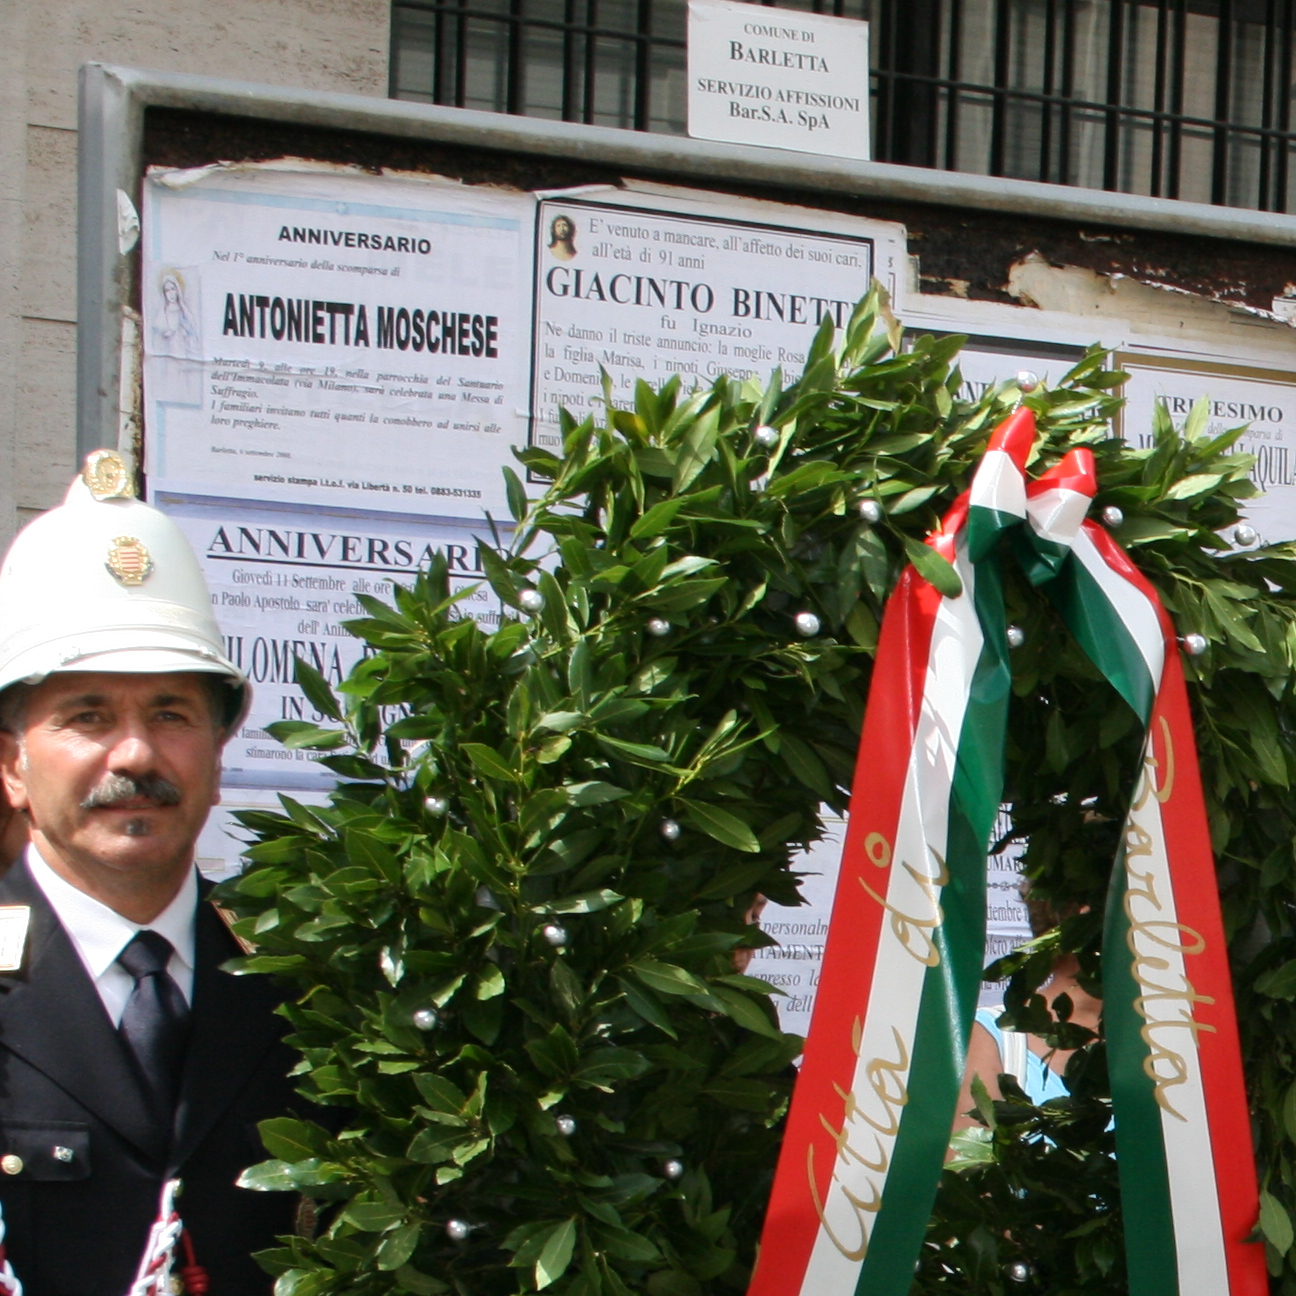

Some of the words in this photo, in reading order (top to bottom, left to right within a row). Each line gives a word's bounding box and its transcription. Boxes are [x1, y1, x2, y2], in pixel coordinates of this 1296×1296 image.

[744, 23, 799, 41] COMUNE
[801, 30, 815, 43] DI
[729, 40, 830, 73] BARLETTA
[697, 78, 772, 101] SERVIZIO
[776, 89, 861, 112] AFFISSIONI
[729, 101, 794, 125] Bar.S.A.
[797, 109, 831, 131] SpA
[278, 226, 431, 254] ANNIVERSARIO
[589, 217, 604, 234] E'
[607, 225, 650, 240] venuto
[653, 231, 660, 241] a
[664, 230, 720, 250] mancare,
[723, 234, 783, 258] all'affetto
[786, 239, 805, 260] dei
[807, 245, 834, 264] suoi
[836, 248, 862, 270] cari,
[212, 250, 231, 262] Nel
[246, 255, 308, 269] anniversario
[310, 258, 334, 271] della
[336, 263, 388, 277] scomparsa
[390, 267, 400, 277] di
[592, 242, 633, 262] all'età
[639, 246, 652, 264] di
[659, 249, 674, 266] 91
[677, 252, 706, 270] anni
[546, 266, 715, 314] GIACINTO
[732, 287, 858, 331] BINETT
[223, 293, 370, 347] ANTONIETTA
[377, 306, 498, 358] MOSCHESE
[660, 314, 677, 331] fu
[692, 318, 753, 339] Ignazio
[545, 322, 562, 337] Ne
[567, 324, 604, 342] danno
[609, 328, 618, 343] il
[623, 330, 652, 347] triste
[656, 336, 712, 354] annuncio:
[717, 340, 728, 356] la
[733, 342, 772, 363] moglie
[777, 347, 806, 364] Rosa
[544, 343, 555, 359] la
[564, 346, 595, 364] figlia
[603, 350, 645, 370] Marisa,
[653, 353, 658, 370] i
[665, 356, 699, 377] nipoti
[210, 370, 290, 387] dell'Immacolata
[389, 385, 434, 400] celebrata
[437, 391, 456, 402] una
[462, 392, 491, 404] Messa
[493, 394, 504, 406] di
[274, 363, 293, 373] alle
[300, 366, 316, 375] ore
[345, 368, 370, 380] nella
[377, 371, 429, 386] parrocchia
[436, 374, 451, 386] del
[457, 377, 504, 391] Santuario
[544, 371, 550, 381] e
[620, 374, 631, 389] le
[543, 390, 548, 402] i
[550, 391, 584, 408] nipoti
[1158, 395, 1283, 423] TRIESIMO
[210, 415, 231, 426] loro
[232, 418, 281, 432] preghiere.
[211, 400, 217, 411] I
[219, 400, 263, 414] familiari
[265, 404, 306, 417] invitano
[310, 407, 330, 420] tutti
[334, 410, 366, 424] quanti
[369, 412, 379, 424] la
[382, 414, 433, 429] conobbero
[437, 419, 450, 430] ad
[452, 421, 481, 433] unirsi
[483, 423, 502, 434] alle
[1275, 429, 1283, 441] di
[254, 473, 286, 485] servizio
[287, 476, 318, 488] stampa
[347, 481, 360, 490] via
[291, 574, 346, 592] Settembre
[352, 578, 371, 593] alle
[374, 582, 391, 594] ore
[222, 591, 250, 607] Paolo
[253, 595, 300, 612] Apostolo
[222, 636, 343, 686] ILOMENA
[282, 696, 303, 720] IN
[246, 747, 293, 760] stimarono
[295, 748, 304, 760] la
[858, 832, 950, 968] di
[1124, 716, 1217, 1122] Barletta
[808, 1014, 909, 1262] Città
